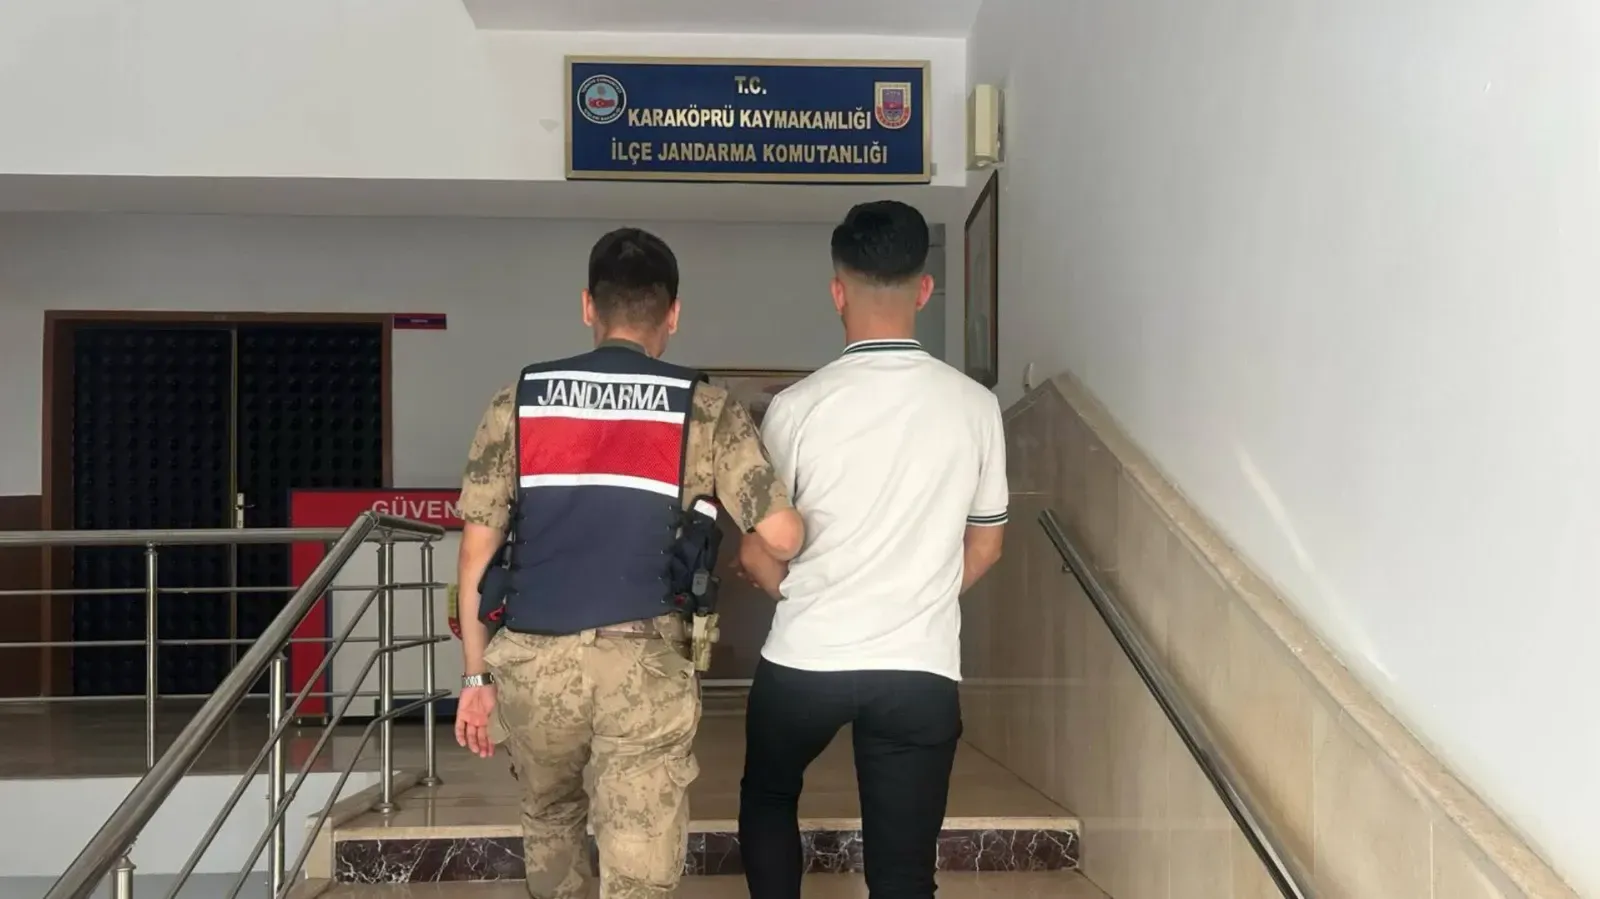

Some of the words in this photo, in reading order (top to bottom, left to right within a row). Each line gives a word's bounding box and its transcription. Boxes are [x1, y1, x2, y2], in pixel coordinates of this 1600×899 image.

[734, 75, 767, 95] T.C.
[627, 104, 735, 128] KARAKÖPRÜ
[739, 106, 872, 130] KAYMAKAMLIĞI
[611, 137, 653, 165] İLÇE
[657, 142, 757, 162] JANDARMA
[762, 141, 888, 164] KOMUTANLIĞI
[537, 379, 671, 412] JANDARMA
